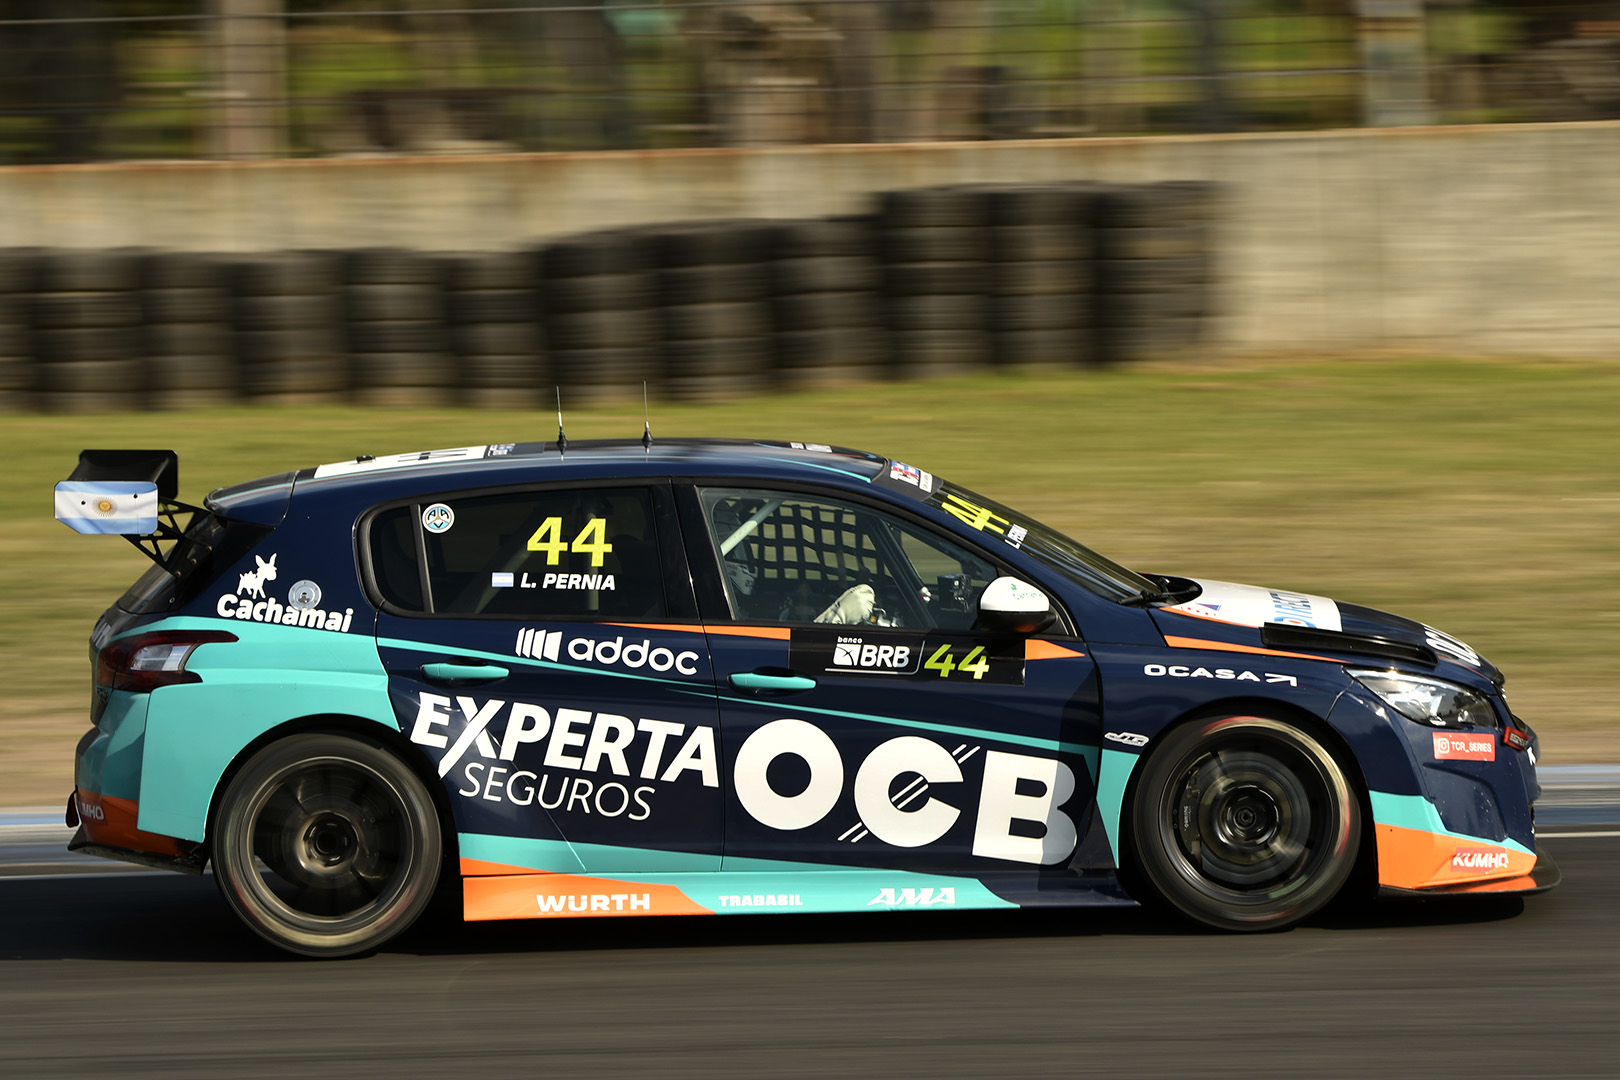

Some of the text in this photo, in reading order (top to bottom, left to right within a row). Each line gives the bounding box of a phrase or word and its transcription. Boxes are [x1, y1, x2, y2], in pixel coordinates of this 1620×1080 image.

[940, 493, 1010, 533] 44
[527, 517, 612, 567] 44
[521, 573, 615, 591] L. PERNIA
[216, 593, 353, 632] Cachamai
[837, 636, 862, 644] banco
[567, 636, 699, 675] addoc
[860, 645, 911, 668] BRB
[924, 644, 990, 680] 44
[1143, 664, 1261, 682] OCASA
[410, 691, 719, 788] EXPERTA
[1450, 741, 1492, 753] TCR_SERIES
[458, 762, 656, 821] SEGUROS
[733, 718, 1077, 866] OCB
[1453, 853, 1508, 868] KUMHO
[718, 894, 804, 907] TRABASIL
[867, 887, 956, 906] AMA
